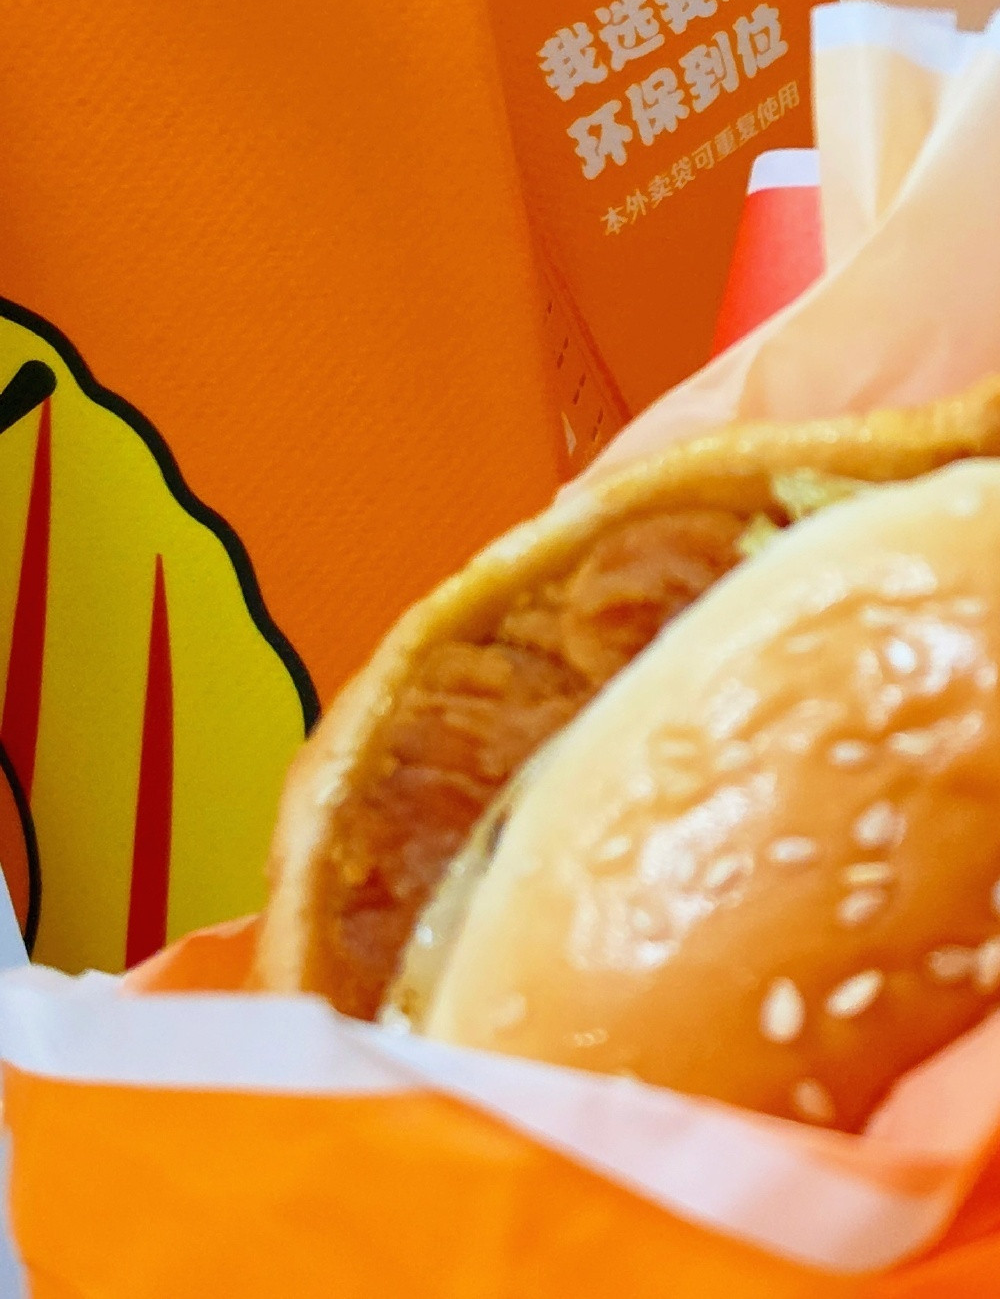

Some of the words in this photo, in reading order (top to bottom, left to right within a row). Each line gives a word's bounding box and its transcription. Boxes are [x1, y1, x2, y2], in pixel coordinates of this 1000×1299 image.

[567, 3, 788, 180] 环保到位
[600, 81, 800, 235] 本外卖袋可重复使用
